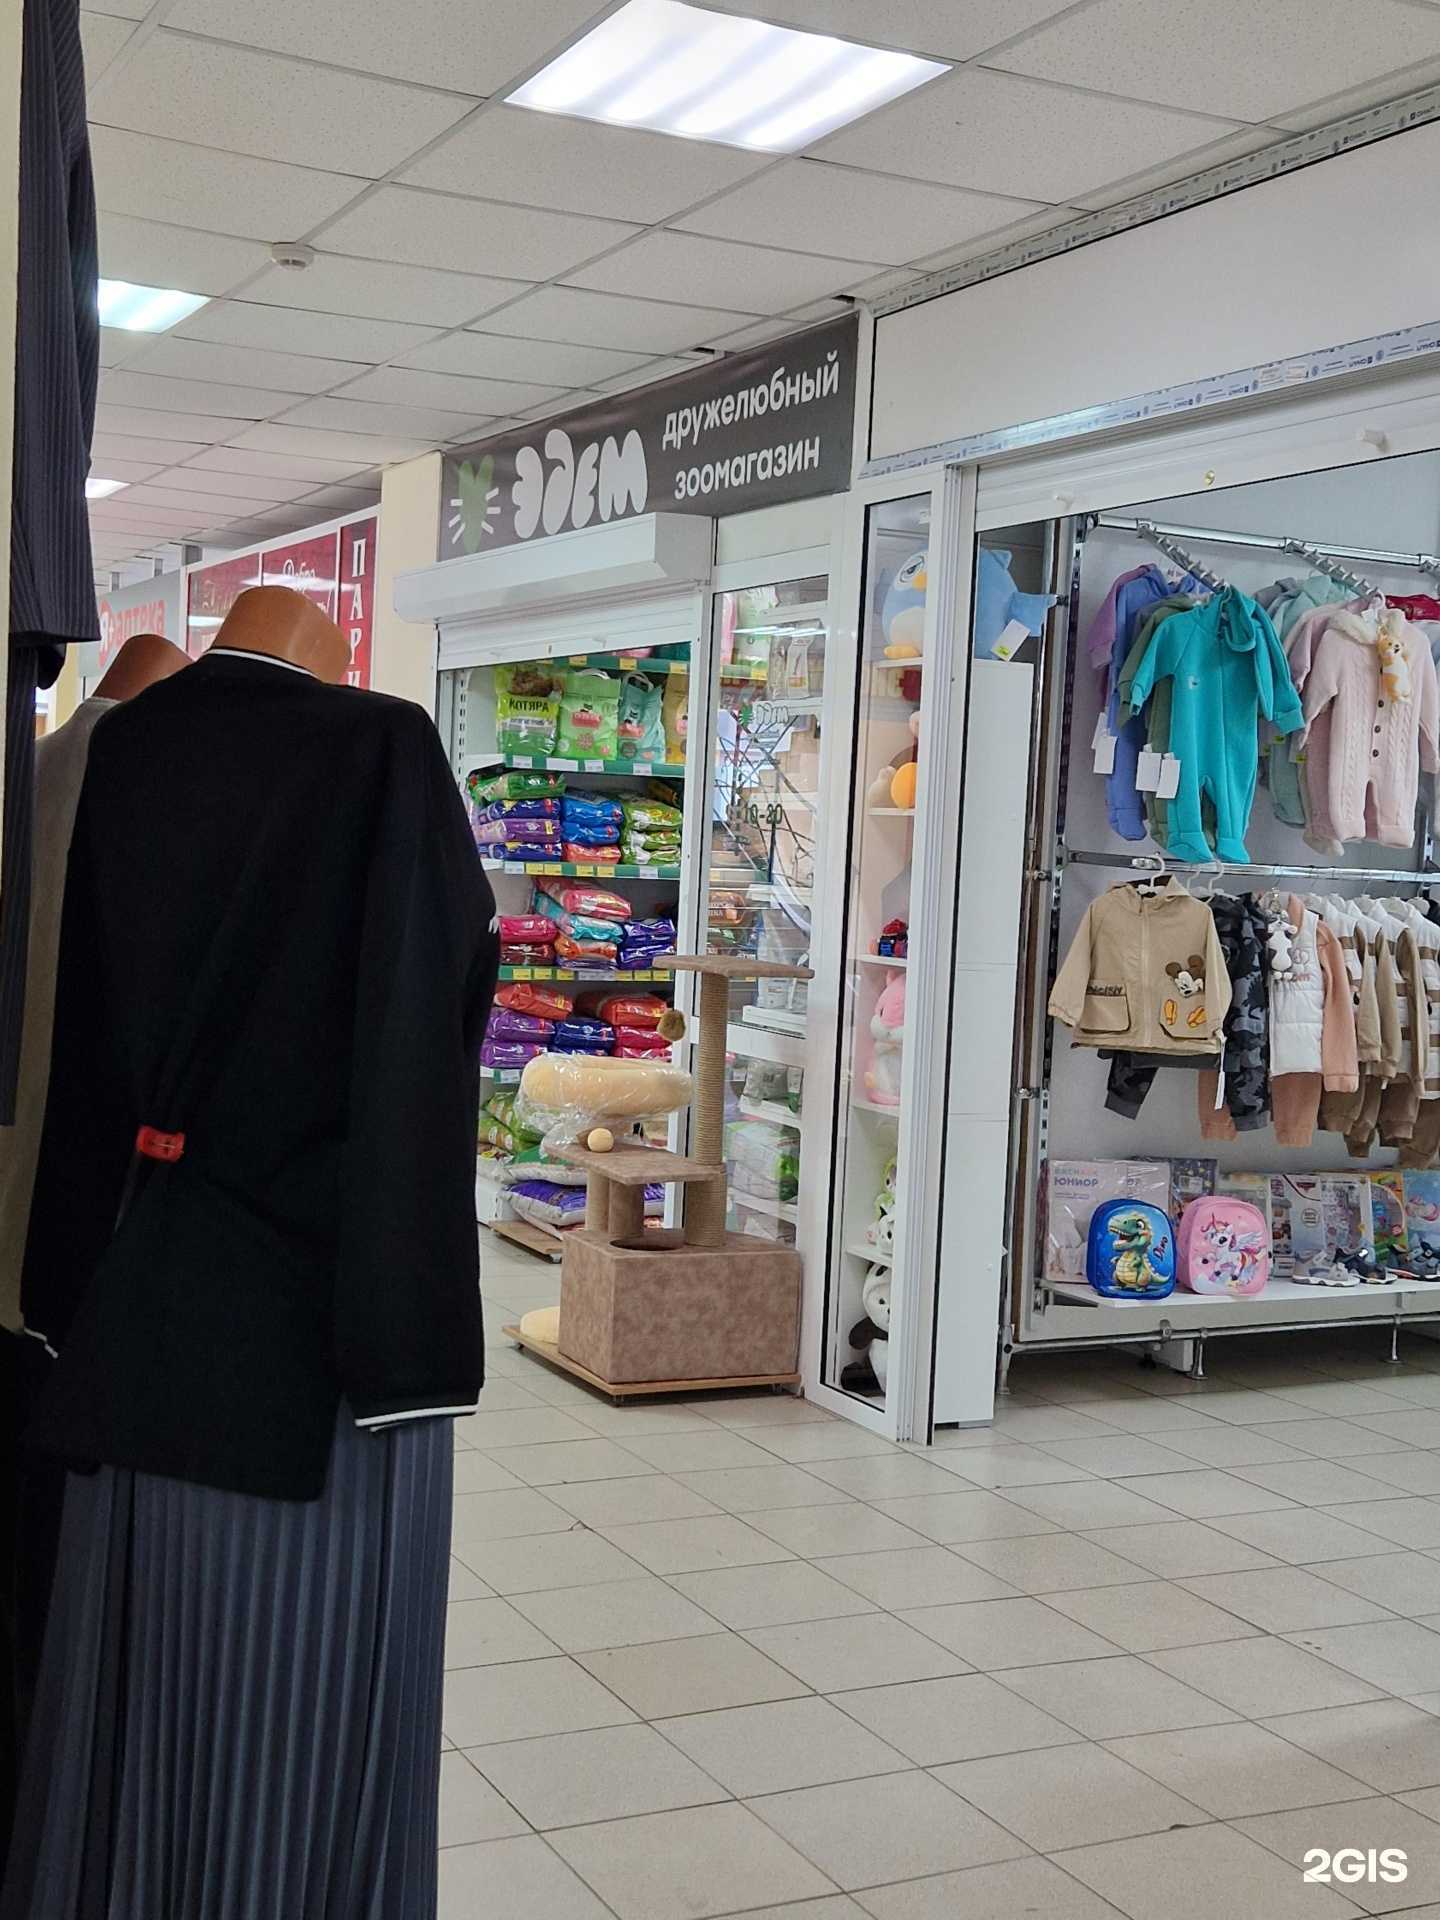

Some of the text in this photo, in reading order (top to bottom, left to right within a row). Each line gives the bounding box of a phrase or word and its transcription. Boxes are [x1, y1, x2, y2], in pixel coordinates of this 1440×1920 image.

[662, 350, 840, 450] дружелюбный
[674, 436, 821, 501] зоомагазин
[509, 698, 549, 712] КОТЯРА
